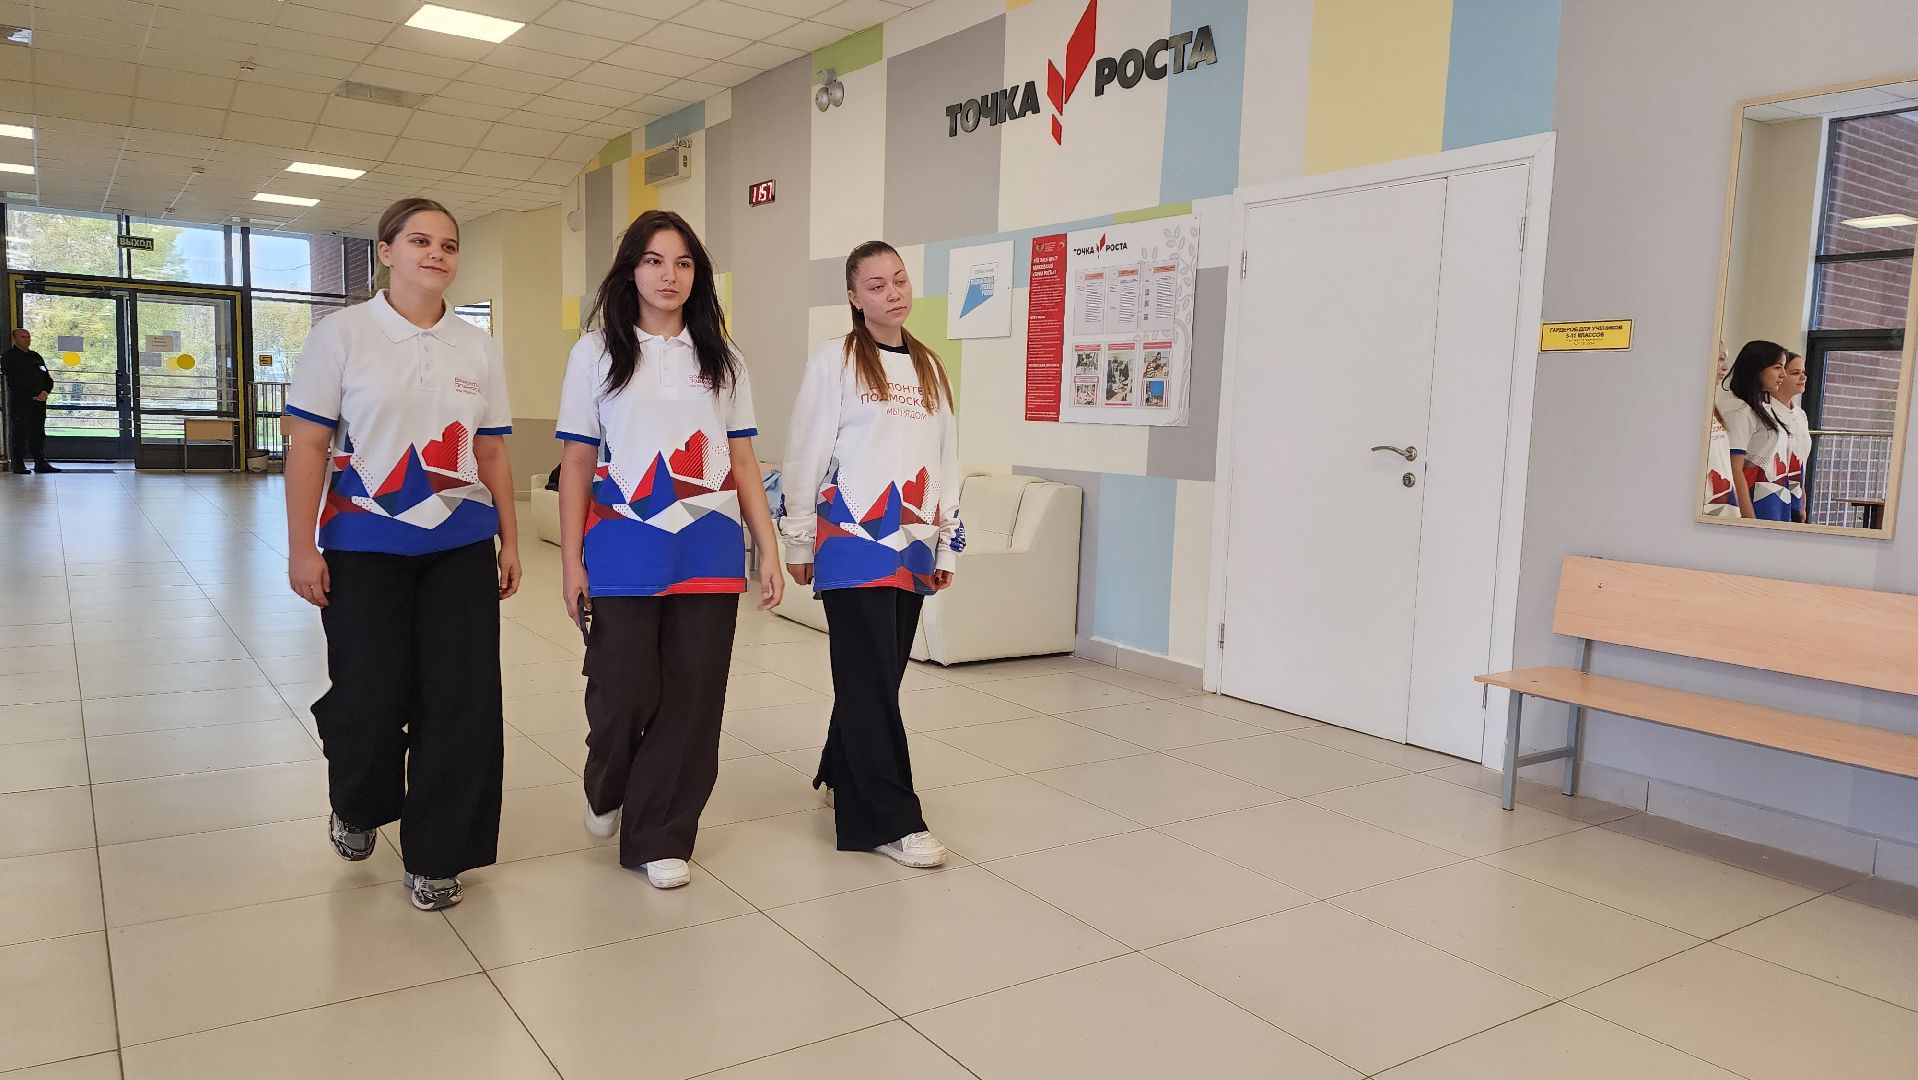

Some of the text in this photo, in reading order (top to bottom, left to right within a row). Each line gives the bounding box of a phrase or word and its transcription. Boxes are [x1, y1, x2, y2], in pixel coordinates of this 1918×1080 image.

[946, 25, 1217, 137] ТОЧКА РОСТА
[120, 238, 152, 249] ВЫХОД
[1105, 242, 1127, 252] РОСТА
